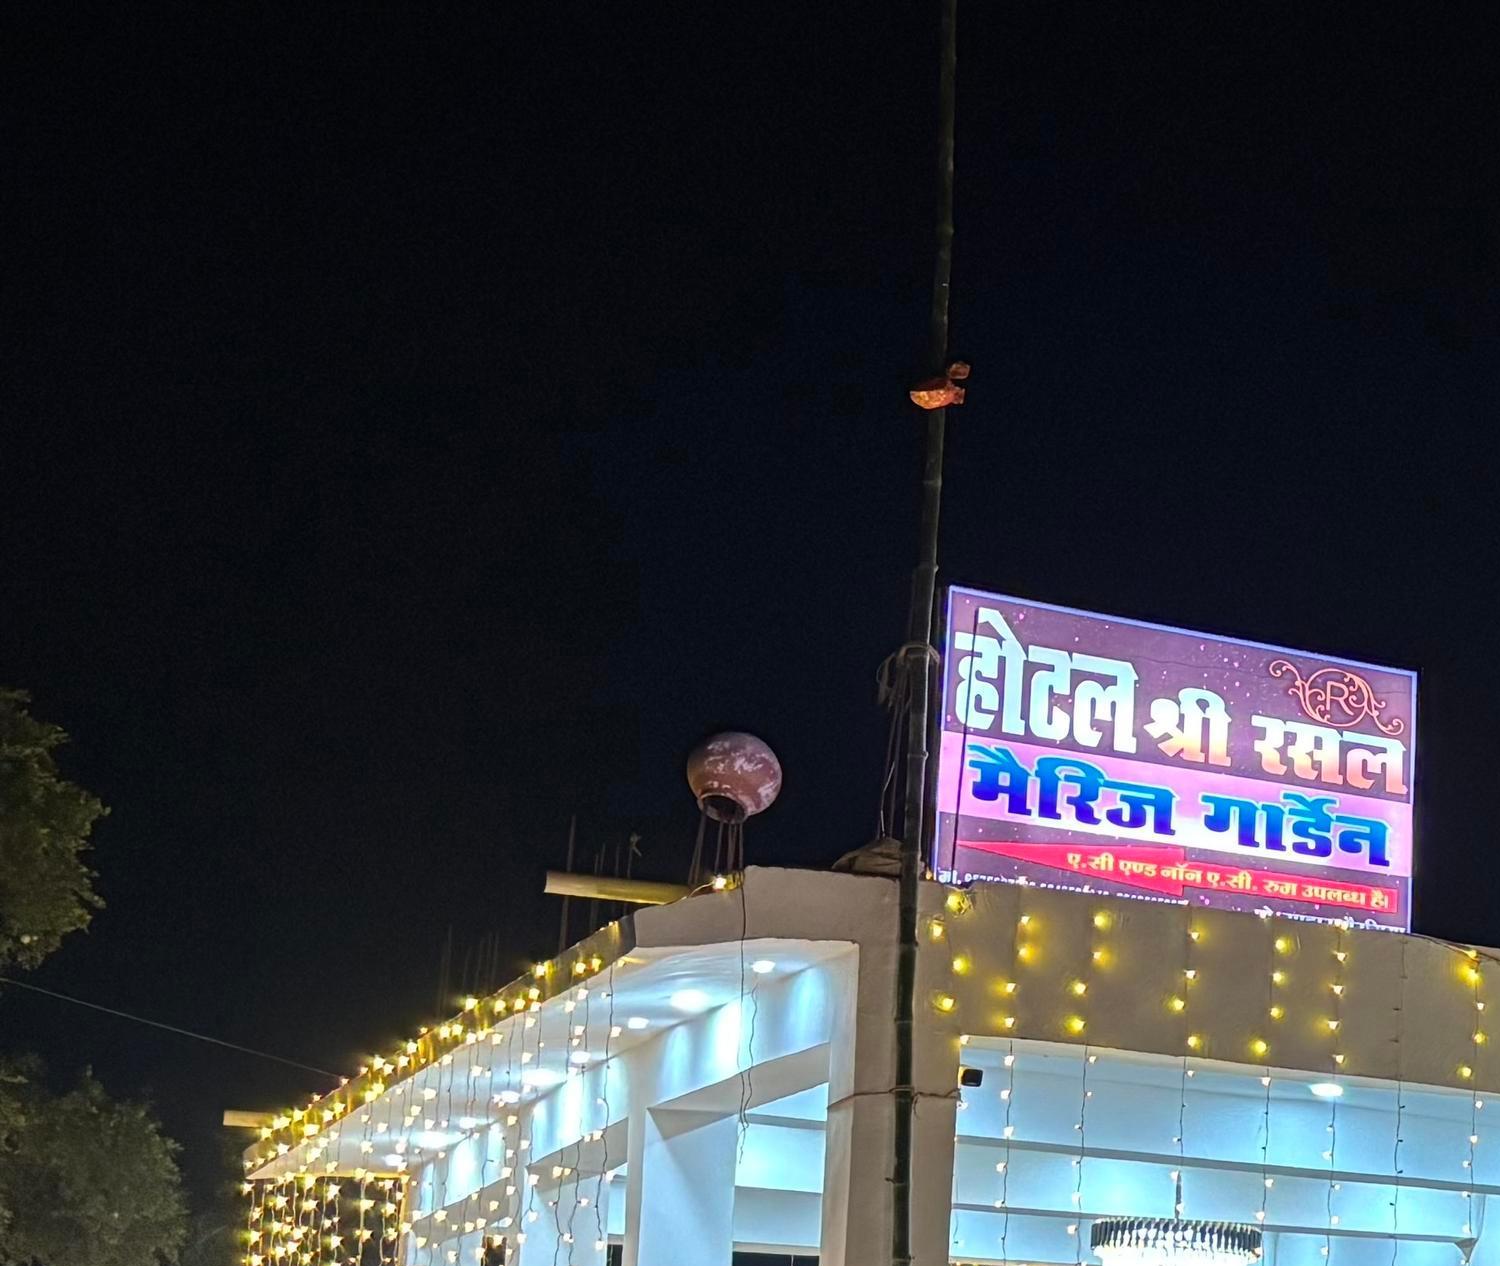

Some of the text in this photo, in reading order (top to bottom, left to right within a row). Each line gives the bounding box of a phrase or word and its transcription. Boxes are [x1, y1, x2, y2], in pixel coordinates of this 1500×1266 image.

[954, 606, 1408, 795] होटल श्री रसल
[966, 743, 1177, 837] मैरिज
[1118, 859, 1157, 877] एण्ड
[1160, 861, 1203, 883] नॉन
[1302, 884, 1366, 905] उपलब्ध
